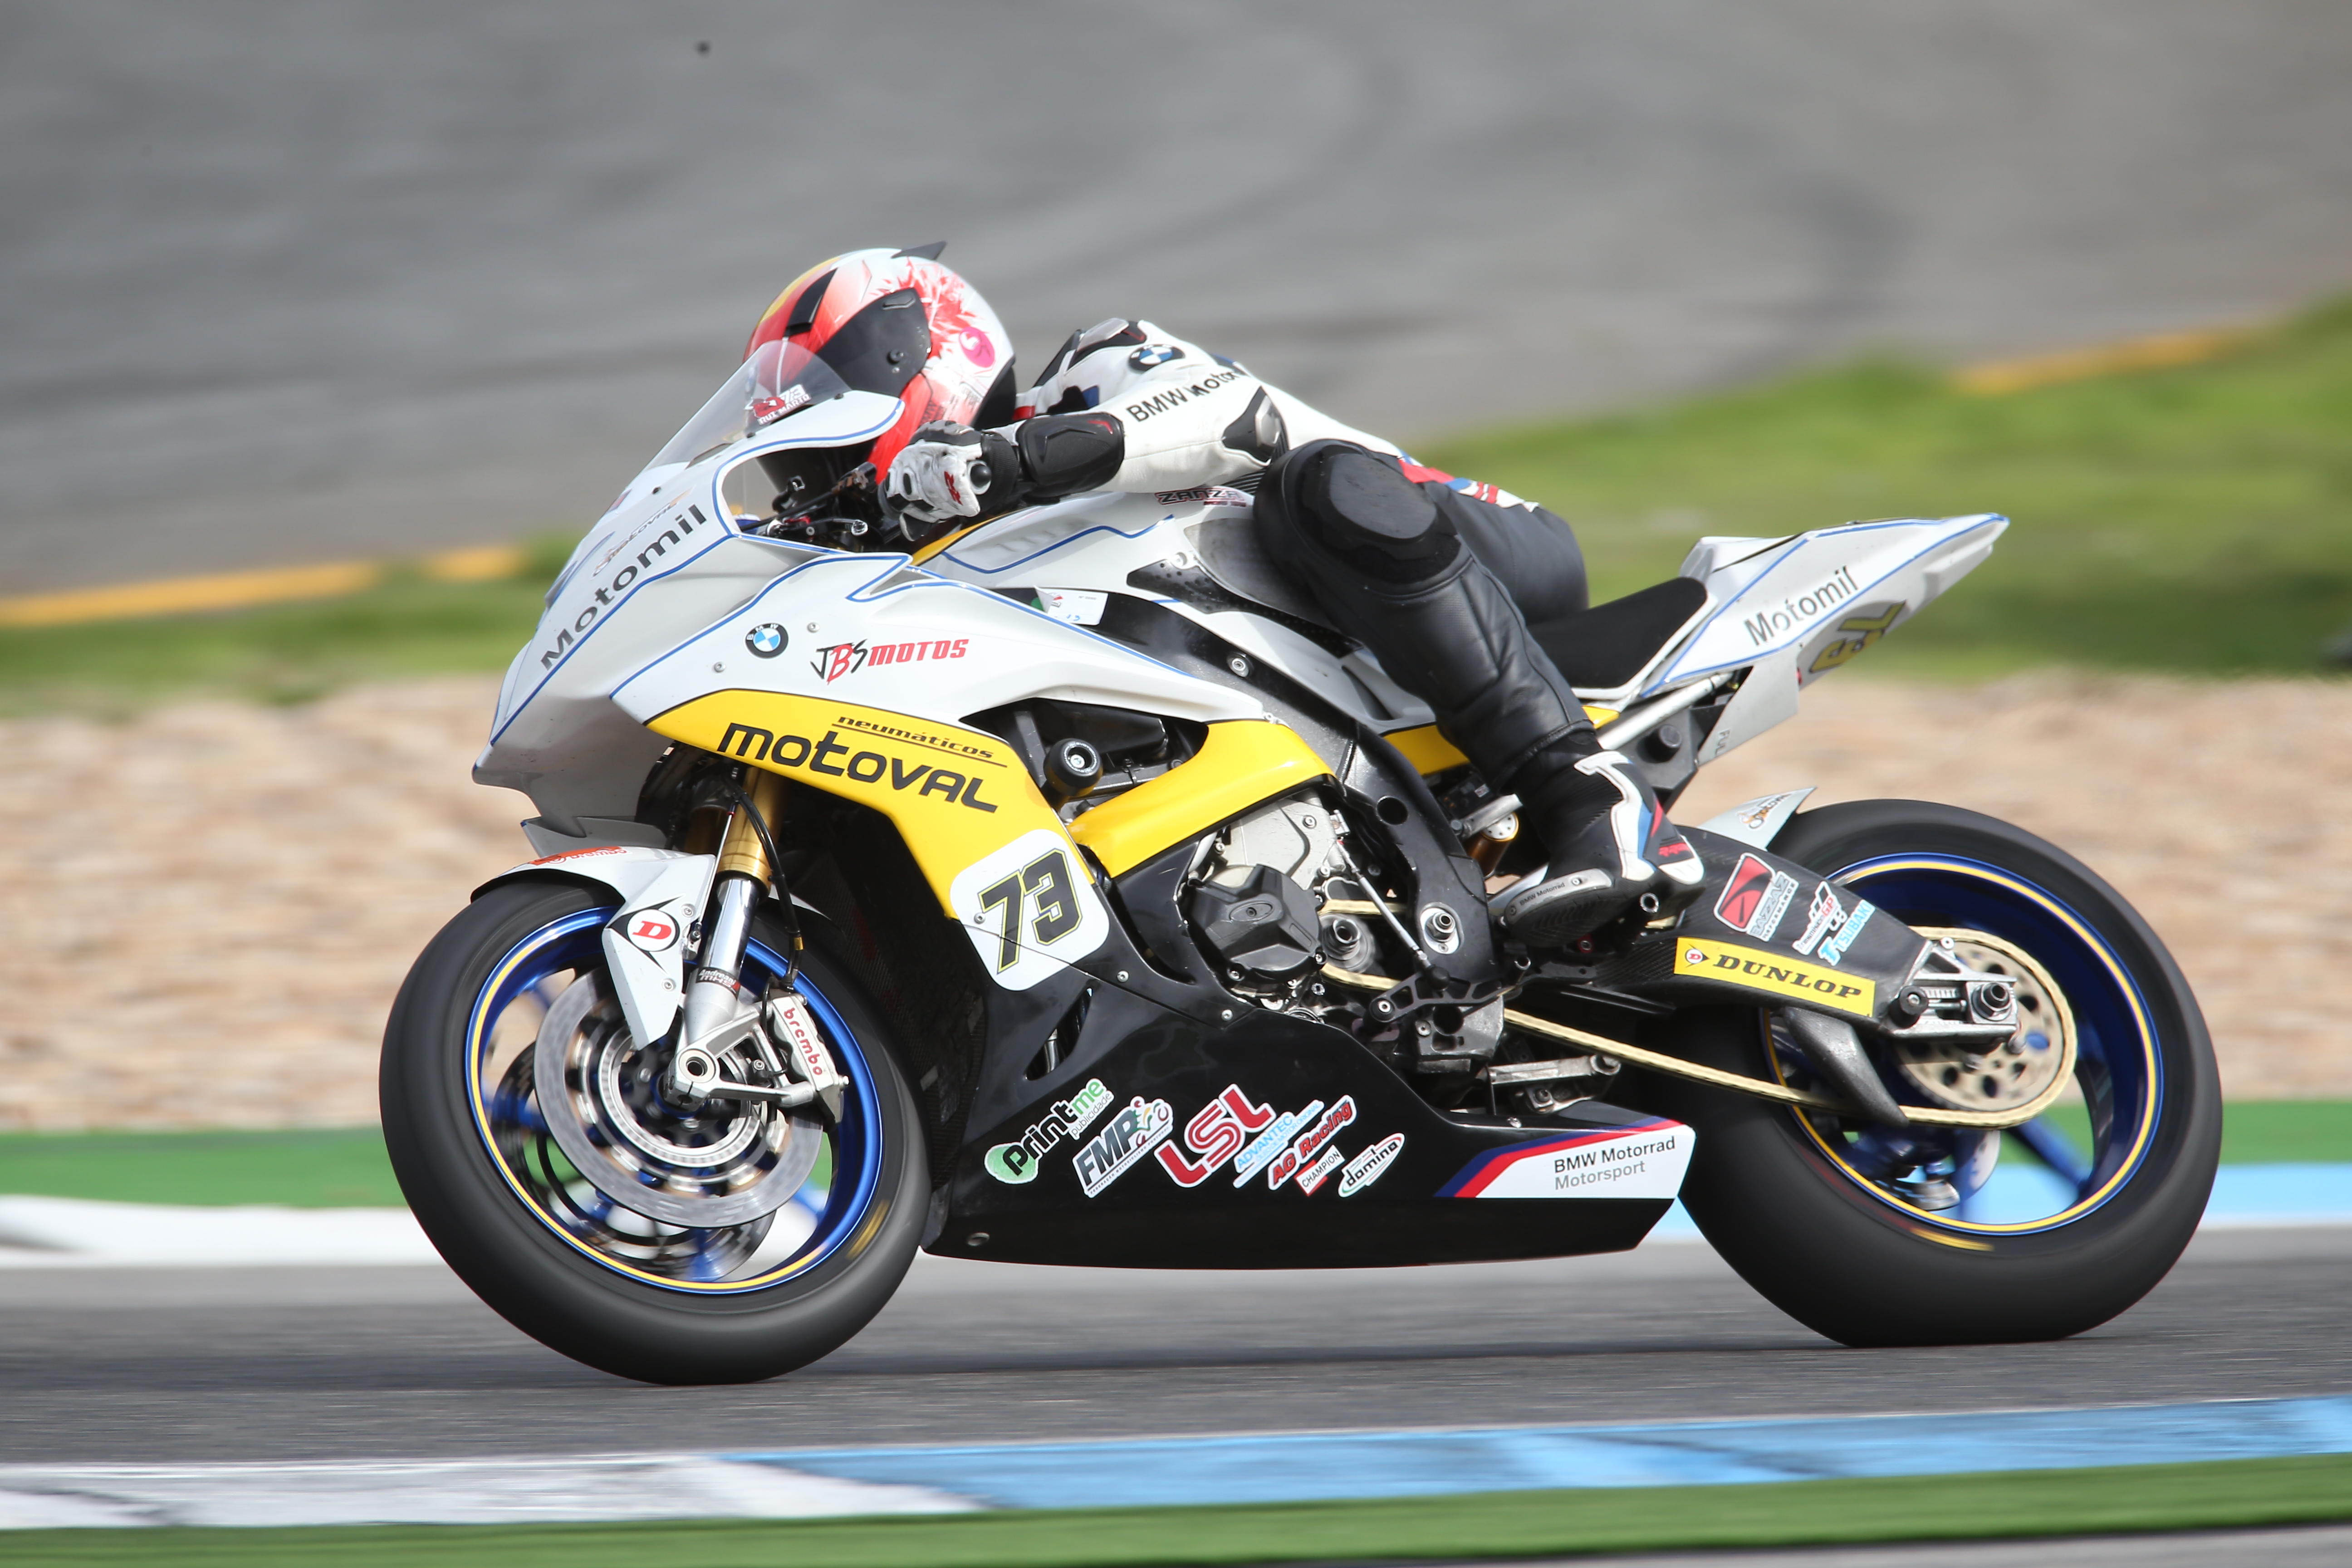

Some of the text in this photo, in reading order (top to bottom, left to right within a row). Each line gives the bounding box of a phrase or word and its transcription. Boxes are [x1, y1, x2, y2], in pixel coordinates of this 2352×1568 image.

[760, 412, 777, 424] RUI
[1126, 388, 1188, 422] BMW
[541, 505, 706, 670] Motomil
[1744, 565, 1859, 647] Motomil
[838, 717, 994, 759] neumáticos
[977, 848, 1083, 975] 73
[1520, 882, 1565, 906] BMW Motorrad
[1749, 874, 1789, 936] BAZZAZ
[632, 920, 672, 940] D
[1833, 902, 1872, 949] TSUBAKI
[1713, 954, 1862, 999] DUNLOP
[784, 1007, 823, 1076] brembo
[1071, 1093, 1112, 1137] publicidade
[1158, 1089, 1272, 1184] LSL
[1076, 1110, 1138, 1186] FMP
[1238, 1116, 1292, 1168] ADVANTEC
[1273, 1102, 1352, 1186] AG Racing
[1346, 1141, 1398, 1187] domino
[1554, 1136, 1676, 1173] BMW Motorrad
[1302, 1151, 1341, 1187] CHAMPION
[1555, 1160, 1646, 1191] Motorsport
